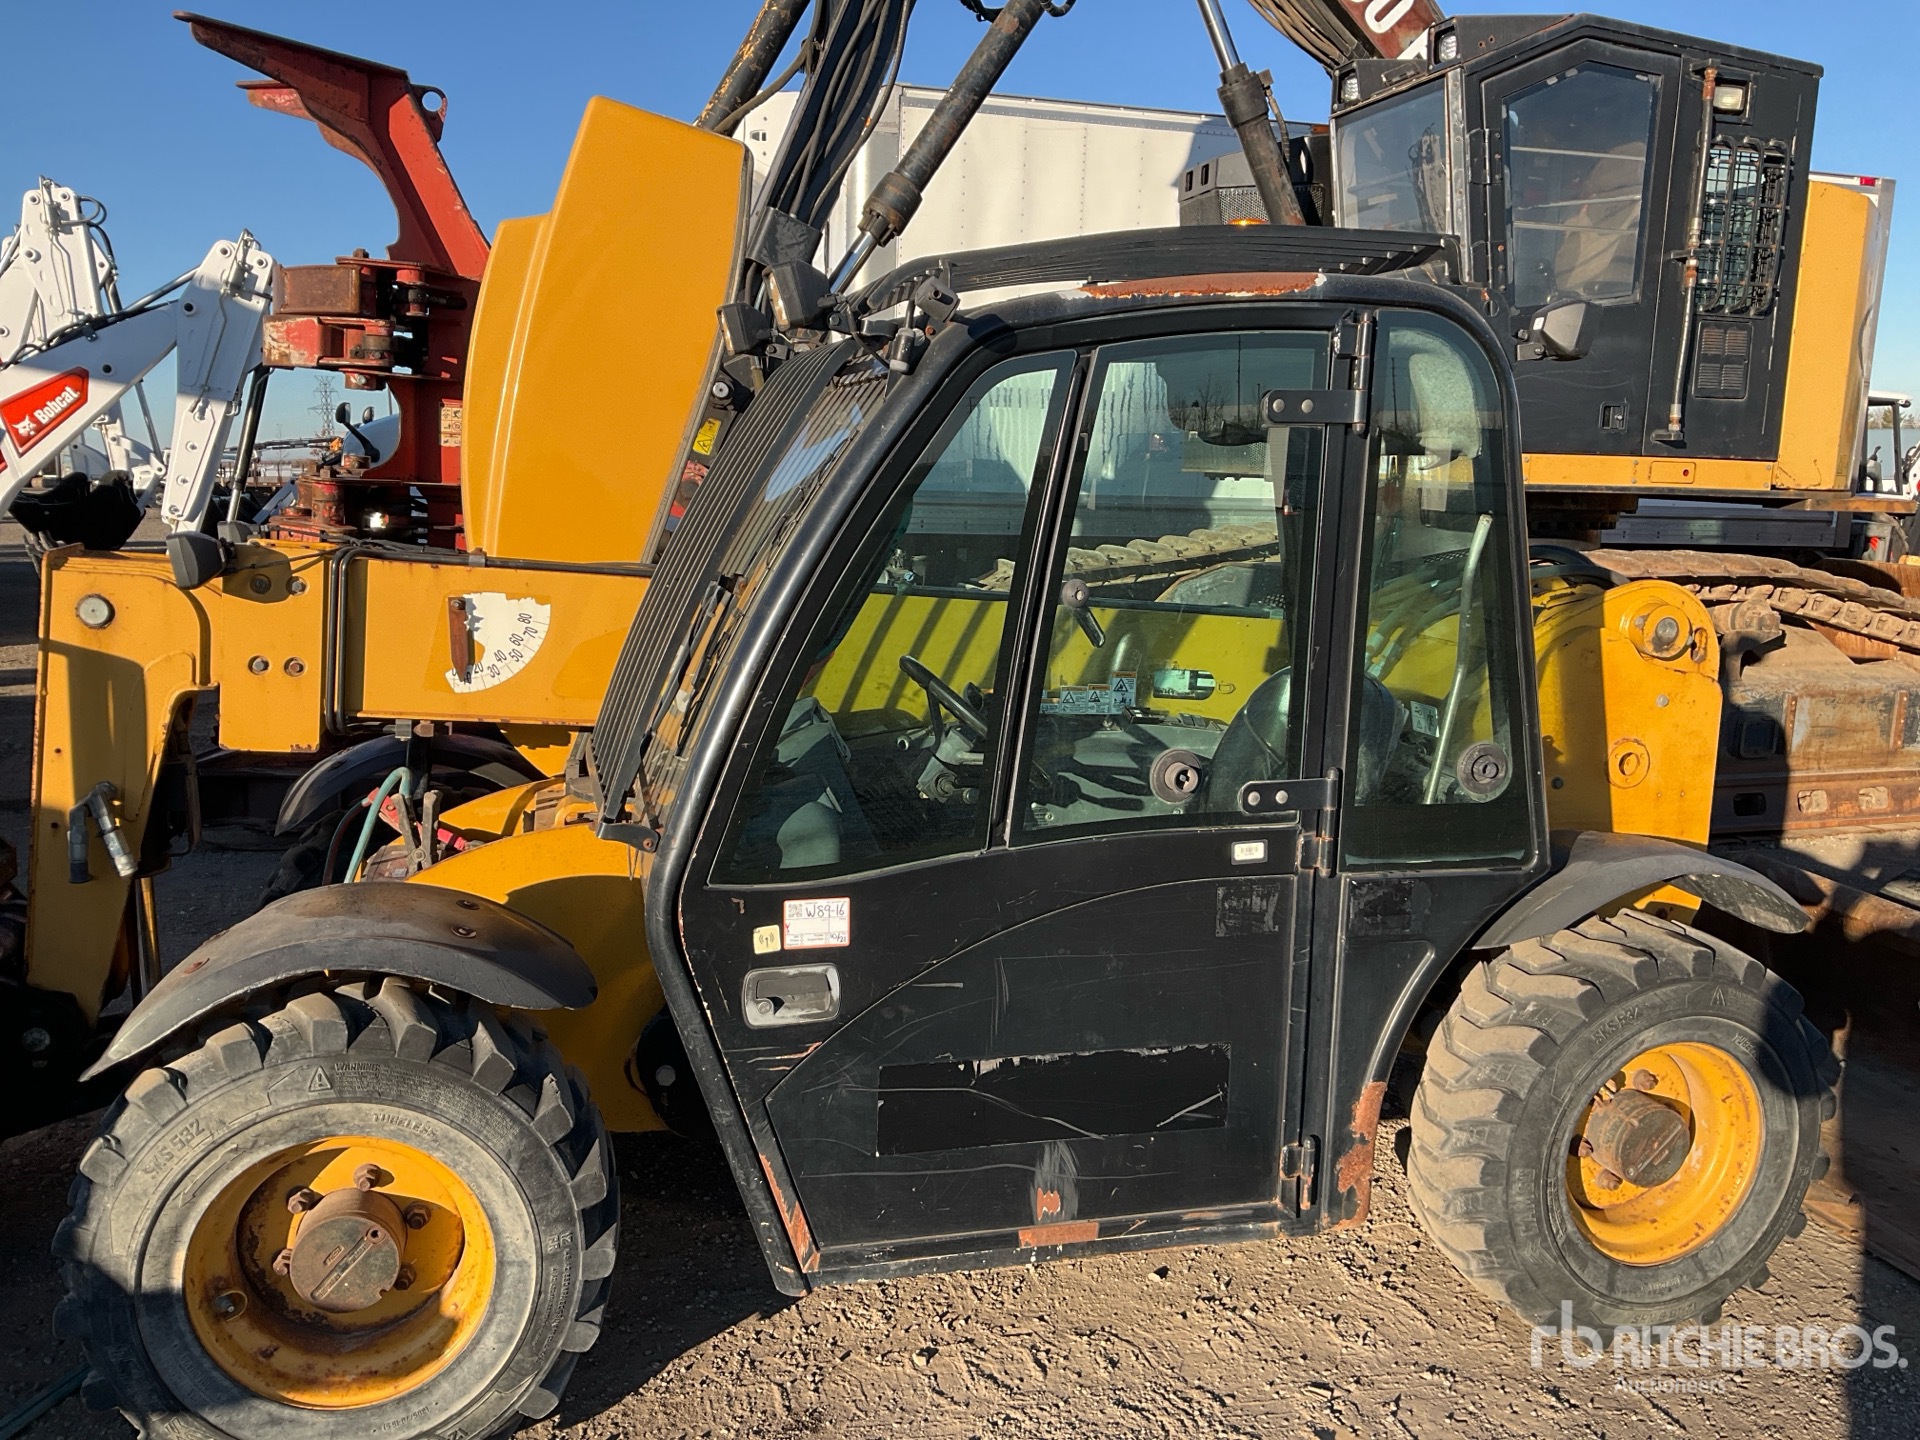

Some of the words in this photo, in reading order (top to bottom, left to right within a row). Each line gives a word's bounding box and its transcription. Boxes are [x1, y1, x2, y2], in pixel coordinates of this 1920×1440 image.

[33, 386, 79, 425] Bobcat
[517, 612, 532, 624] 80
[509, 633, 524, 646] 60
[523, 626, 538, 639] 70
[494, 649, 507, 663] 40
[508, 648, 523, 662] 50
[474, 662, 484, 674] 20
[487, 664, 500, 678] 30
[169, 1118, 205, 1152] 532
